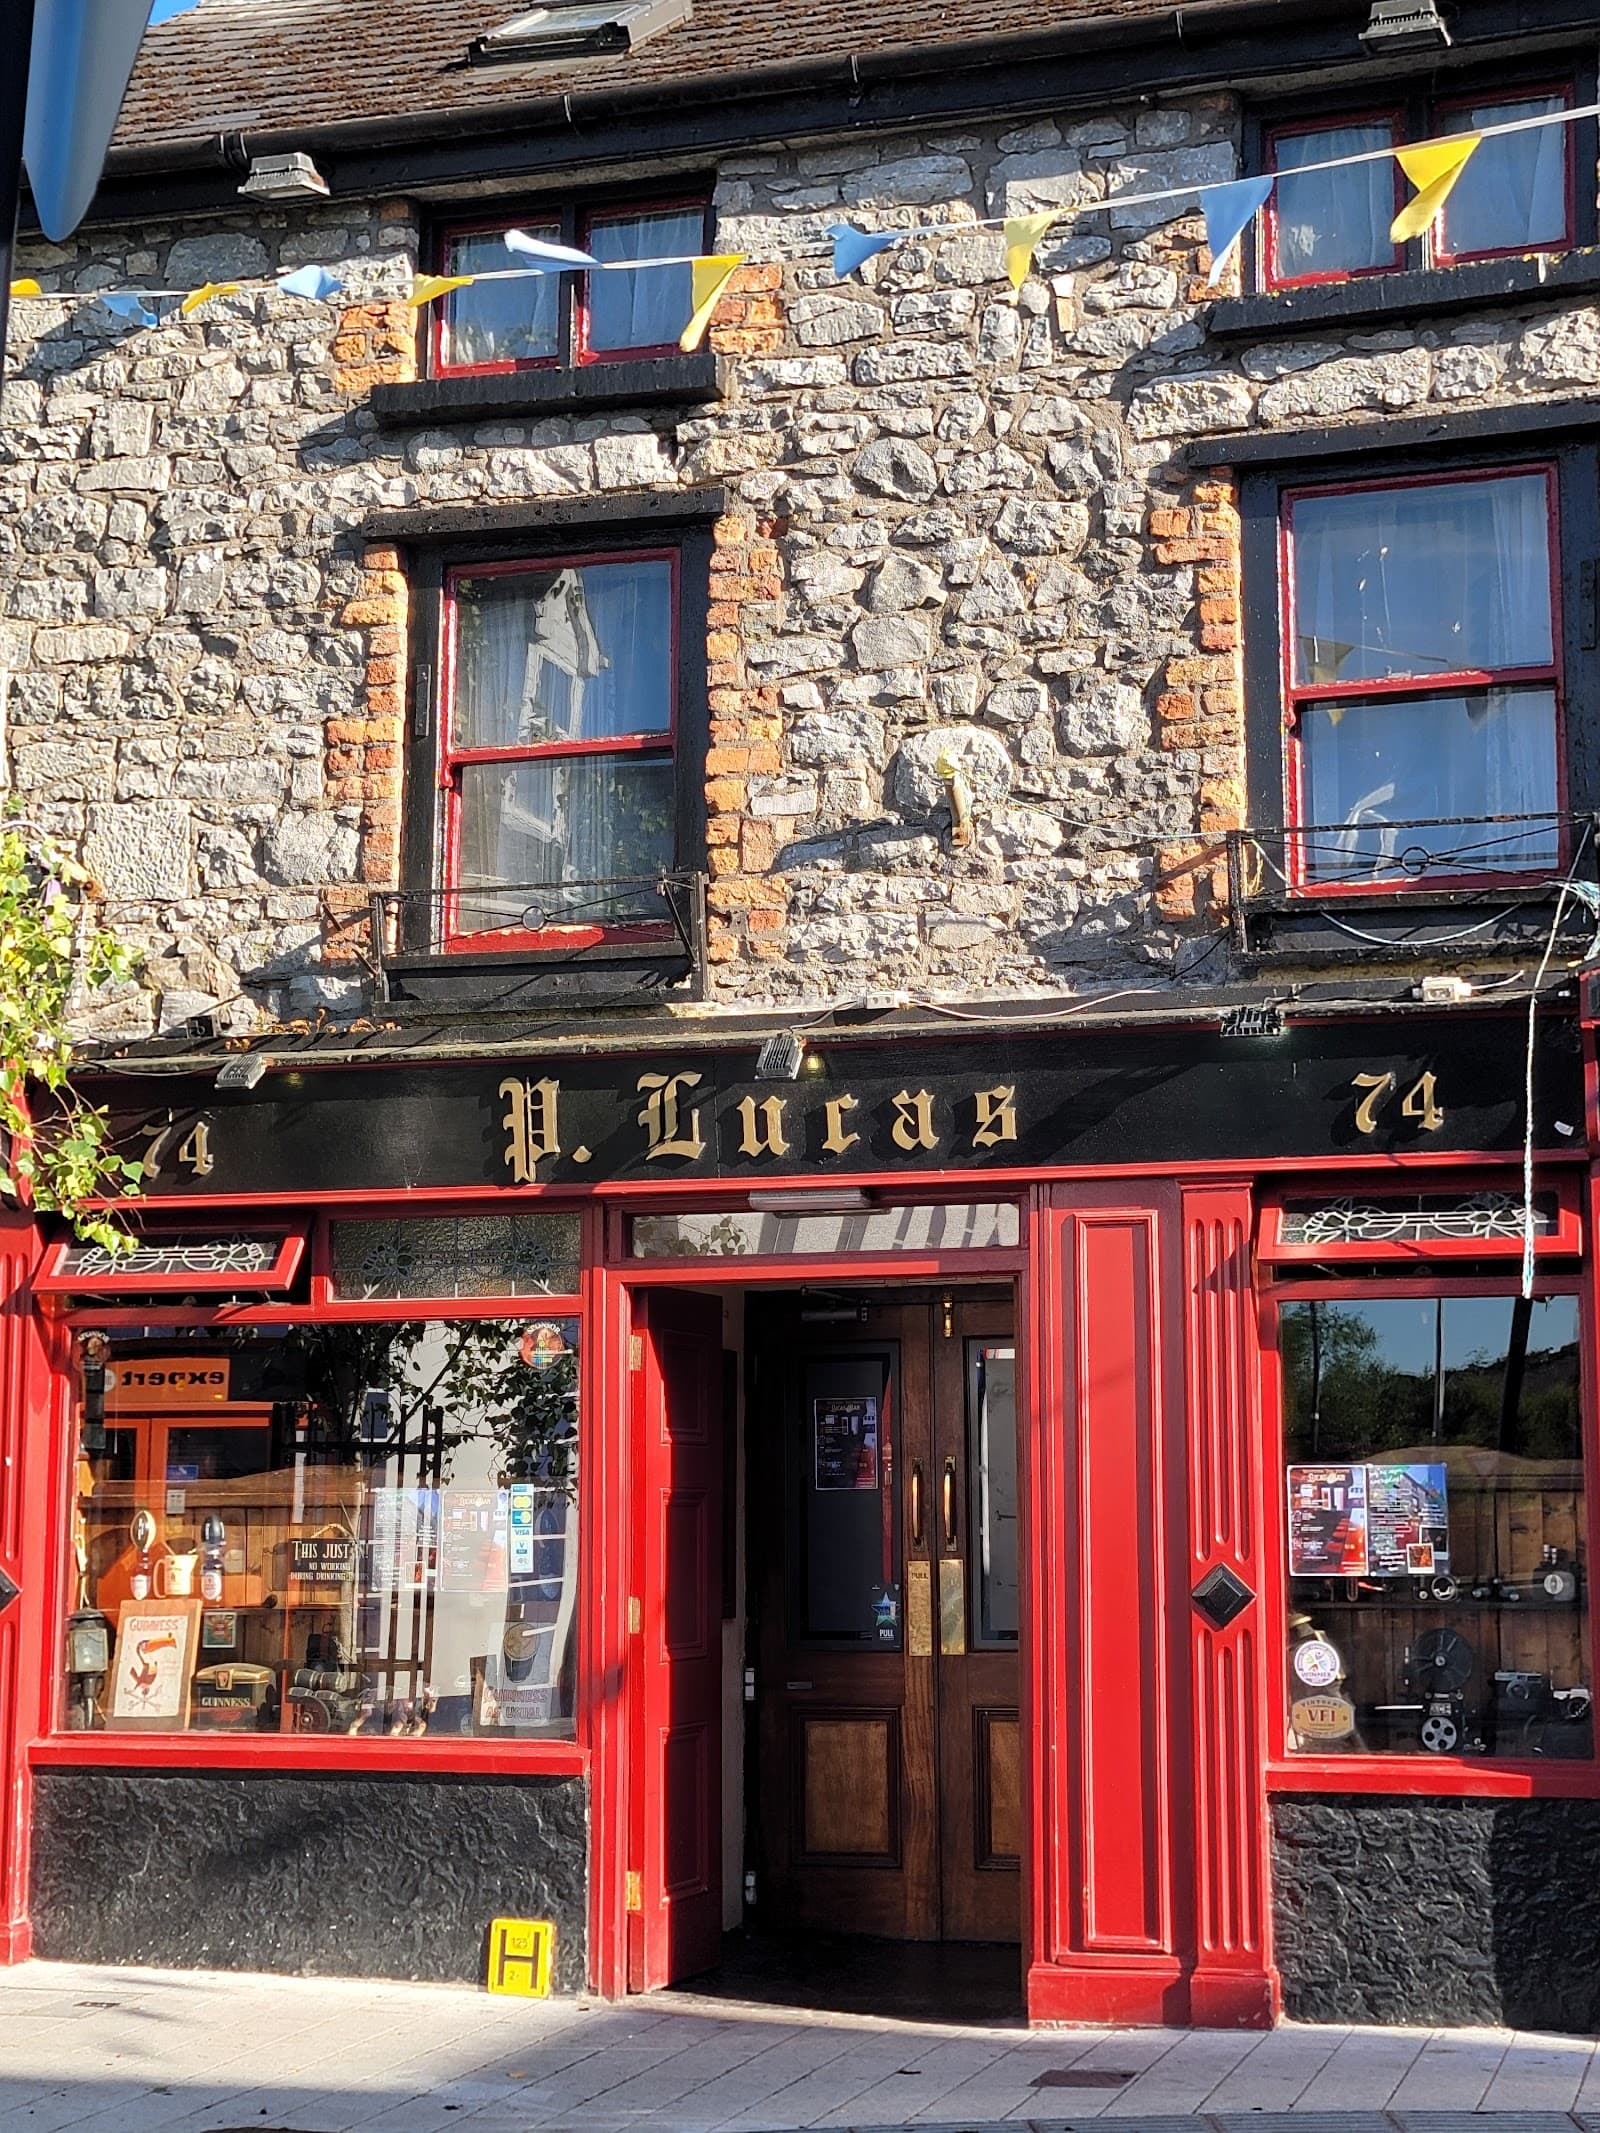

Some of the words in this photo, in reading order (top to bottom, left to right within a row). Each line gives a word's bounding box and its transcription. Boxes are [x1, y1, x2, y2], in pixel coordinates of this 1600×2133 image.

[1352, 1071, 1443, 1133] 74
[499, 1077, 592, 1183] P.
[637, 1071, 1017, 1160] Lucas
[141, 1121, 214, 1178] 74
[129, 1618, 178, 1631] GUINNESS
[879, 1629, 894, 1637] PULL
[201, 1696, 250, 1707] GUINNESS
[484, 1685, 546, 1703] GUINNESS
[1307, 1709, 1336, 1722] VFI
[497, 1929, 541, 1989] H
